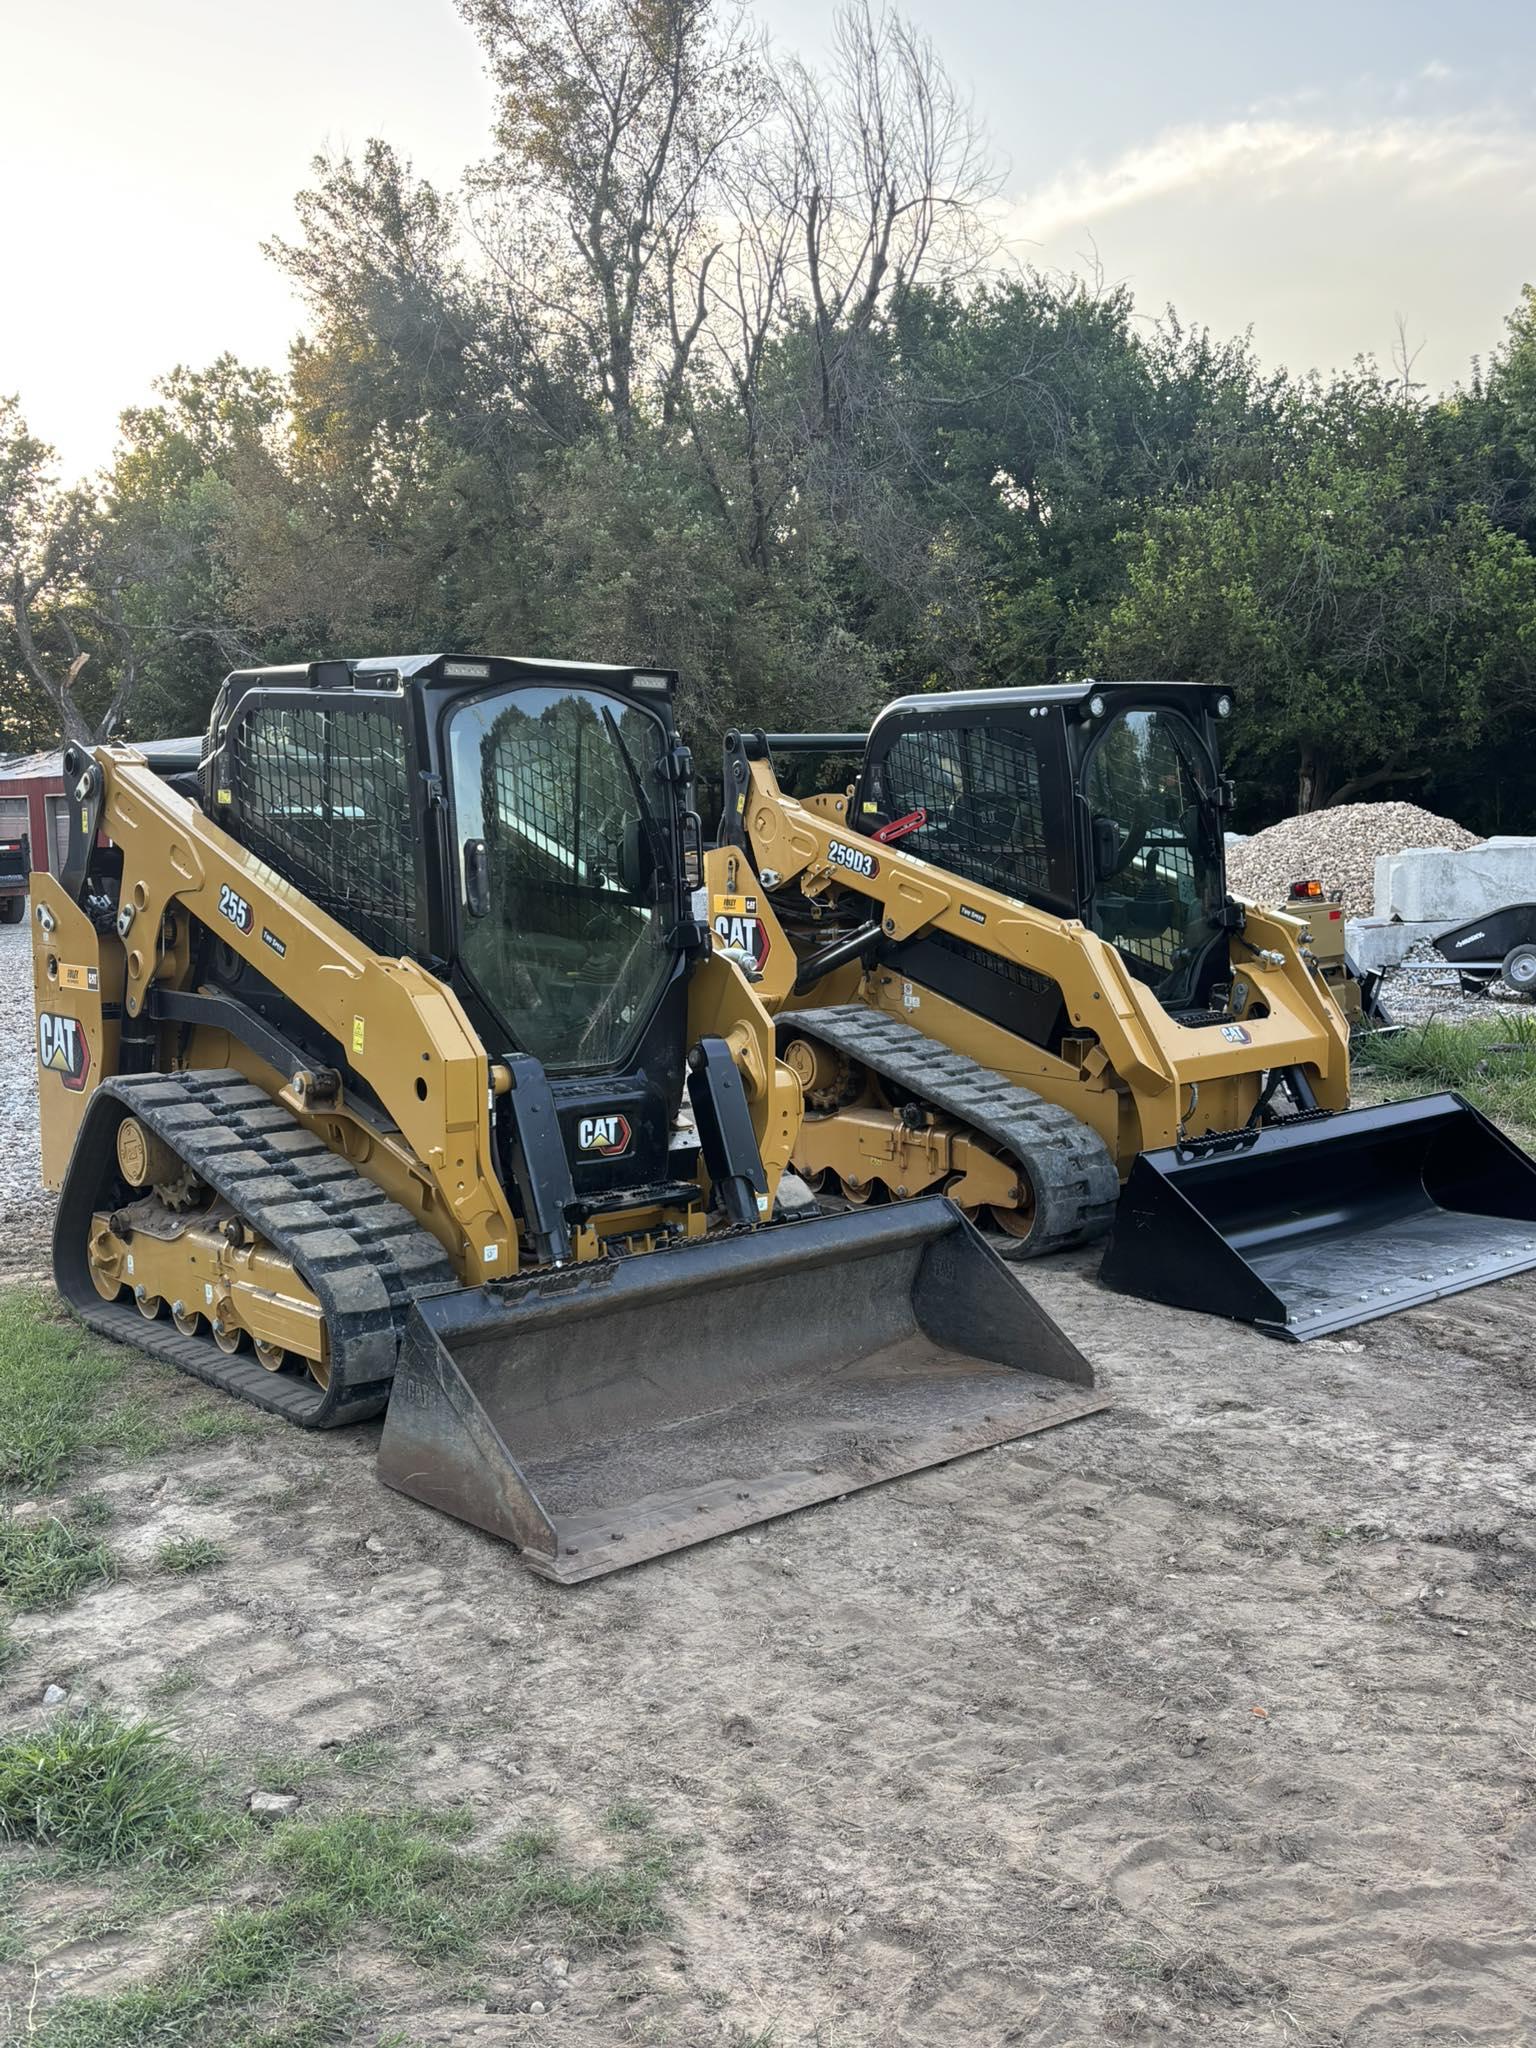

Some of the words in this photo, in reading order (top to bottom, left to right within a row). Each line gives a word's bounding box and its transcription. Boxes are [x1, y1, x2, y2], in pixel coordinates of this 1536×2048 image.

[828, 840, 873, 876] 259D3
[219, 884, 248, 929] 255
[715, 916, 757, 956] CAT
[40, 1013, 77, 1072] CAT
[1221, 1025, 1246, 1042] CAT
[580, 1116, 619, 1149] CAT
